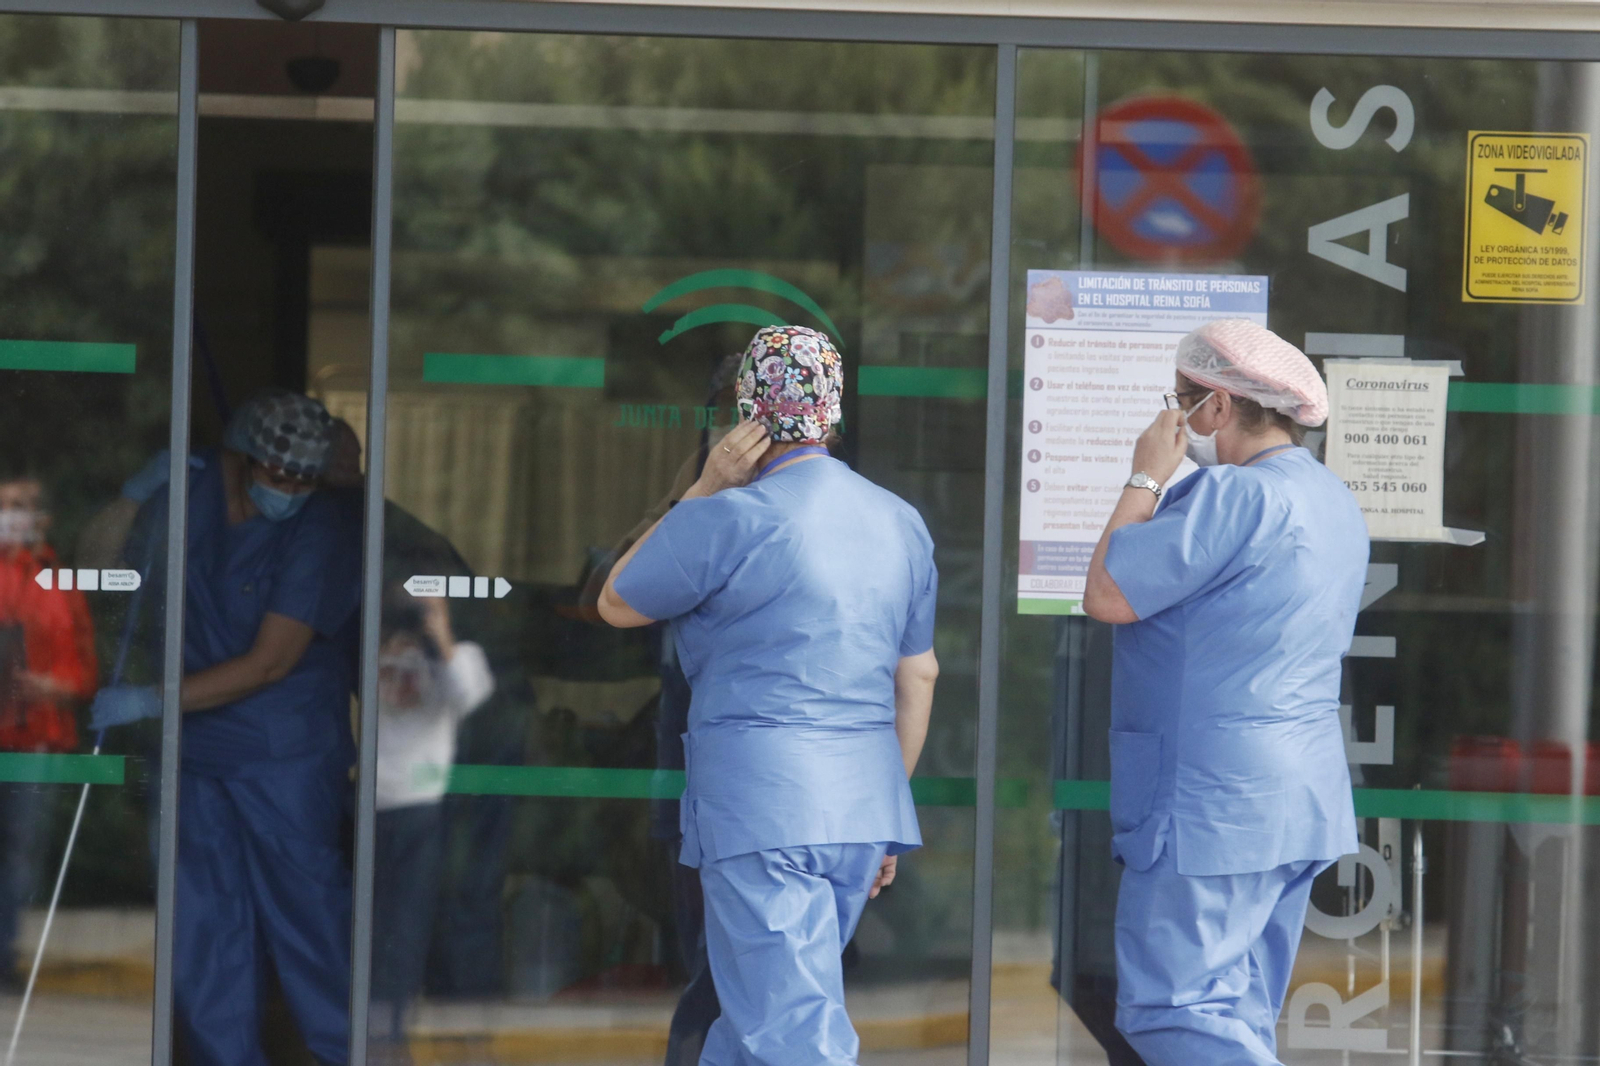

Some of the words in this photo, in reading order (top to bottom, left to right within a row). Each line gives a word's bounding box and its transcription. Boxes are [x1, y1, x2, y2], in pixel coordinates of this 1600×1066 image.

[1478, 144, 1504, 159] ZONA
[1507, 145, 1580, 160] VIDEOVIGILADA
[1480, 245, 1495, 253] LEY
[1497, 243, 1538, 254] ORGÁNICA
[1474, 256, 1484, 264] DE
[1487, 256, 1537, 265] PROTECCIÓN
[1539, 257, 1549, 265] DE
[1551, 258, 1577, 266] DATOS
[1078, 276, 1131, 289] LIMITACIÓN
[1133, 278, 1145, 290] DE
[1148, 277, 1193, 291] TRÁNSITO
[1196, 280, 1208, 292] DE
[1210, 280, 1260, 293] PERSONAS
[1078, 293, 1090, 305] EN
[1093, 293, 1104, 305] EL
[1106, 294, 1151, 307] HOSPITAL
[1153, 295, 1181, 307] REINA
[1183, 294, 1211, 308] SOFÍA
[1036, 337, 1040, 346] 1
[1048, 337, 1077, 347] Reducir
[1079, 339, 1085, 347] el
[1087, 339, 1116, 348] tránsito
[1118, 340, 1127, 349] de
[1129, 342, 1163, 351] personas
[1164, 343, 1178, 352] por
[1034, 380, 1040, 389] 2
[1047, 380, 1065, 389] Usar
[1067, 380, 1073, 389] el
[1075, 381, 1105, 390] teléfono
[1131, 382, 1140, 391] de
[1142, 384, 1166, 392] visitar
[1345, 378, 1430, 391] Coronavirus
[613, 404, 682, 429] JUNTA
[694, 406, 719, 430] DE
[1033, 422, 1038, 431] 3
[1086, 436, 1123, 446] reducción
[1125, 438, 1134, 446] de
[1344, 433, 1369, 444] 900
[1373, 433, 1399, 445] 400
[1403, 434, 1428, 445] 061
[1032, 452, 1037, 461] 4
[1045, 452, 1080, 462] Posponer
[1081, 453, 1092, 462] las
[1094, 454, 1118, 463] visitas
[1031, 480, 1037, 490] 5
[1067, 484, 1088, 492] evitar
[1372, 481, 1397, 492] 545
[1401, 482, 1428, 493] 060
[1390, 507, 1425, 515] HOSPITAL
[1043, 522, 1080, 531] presentan
[107, 571, 128, 579] besam
[1030, 578, 1073, 589] COLABORAR
